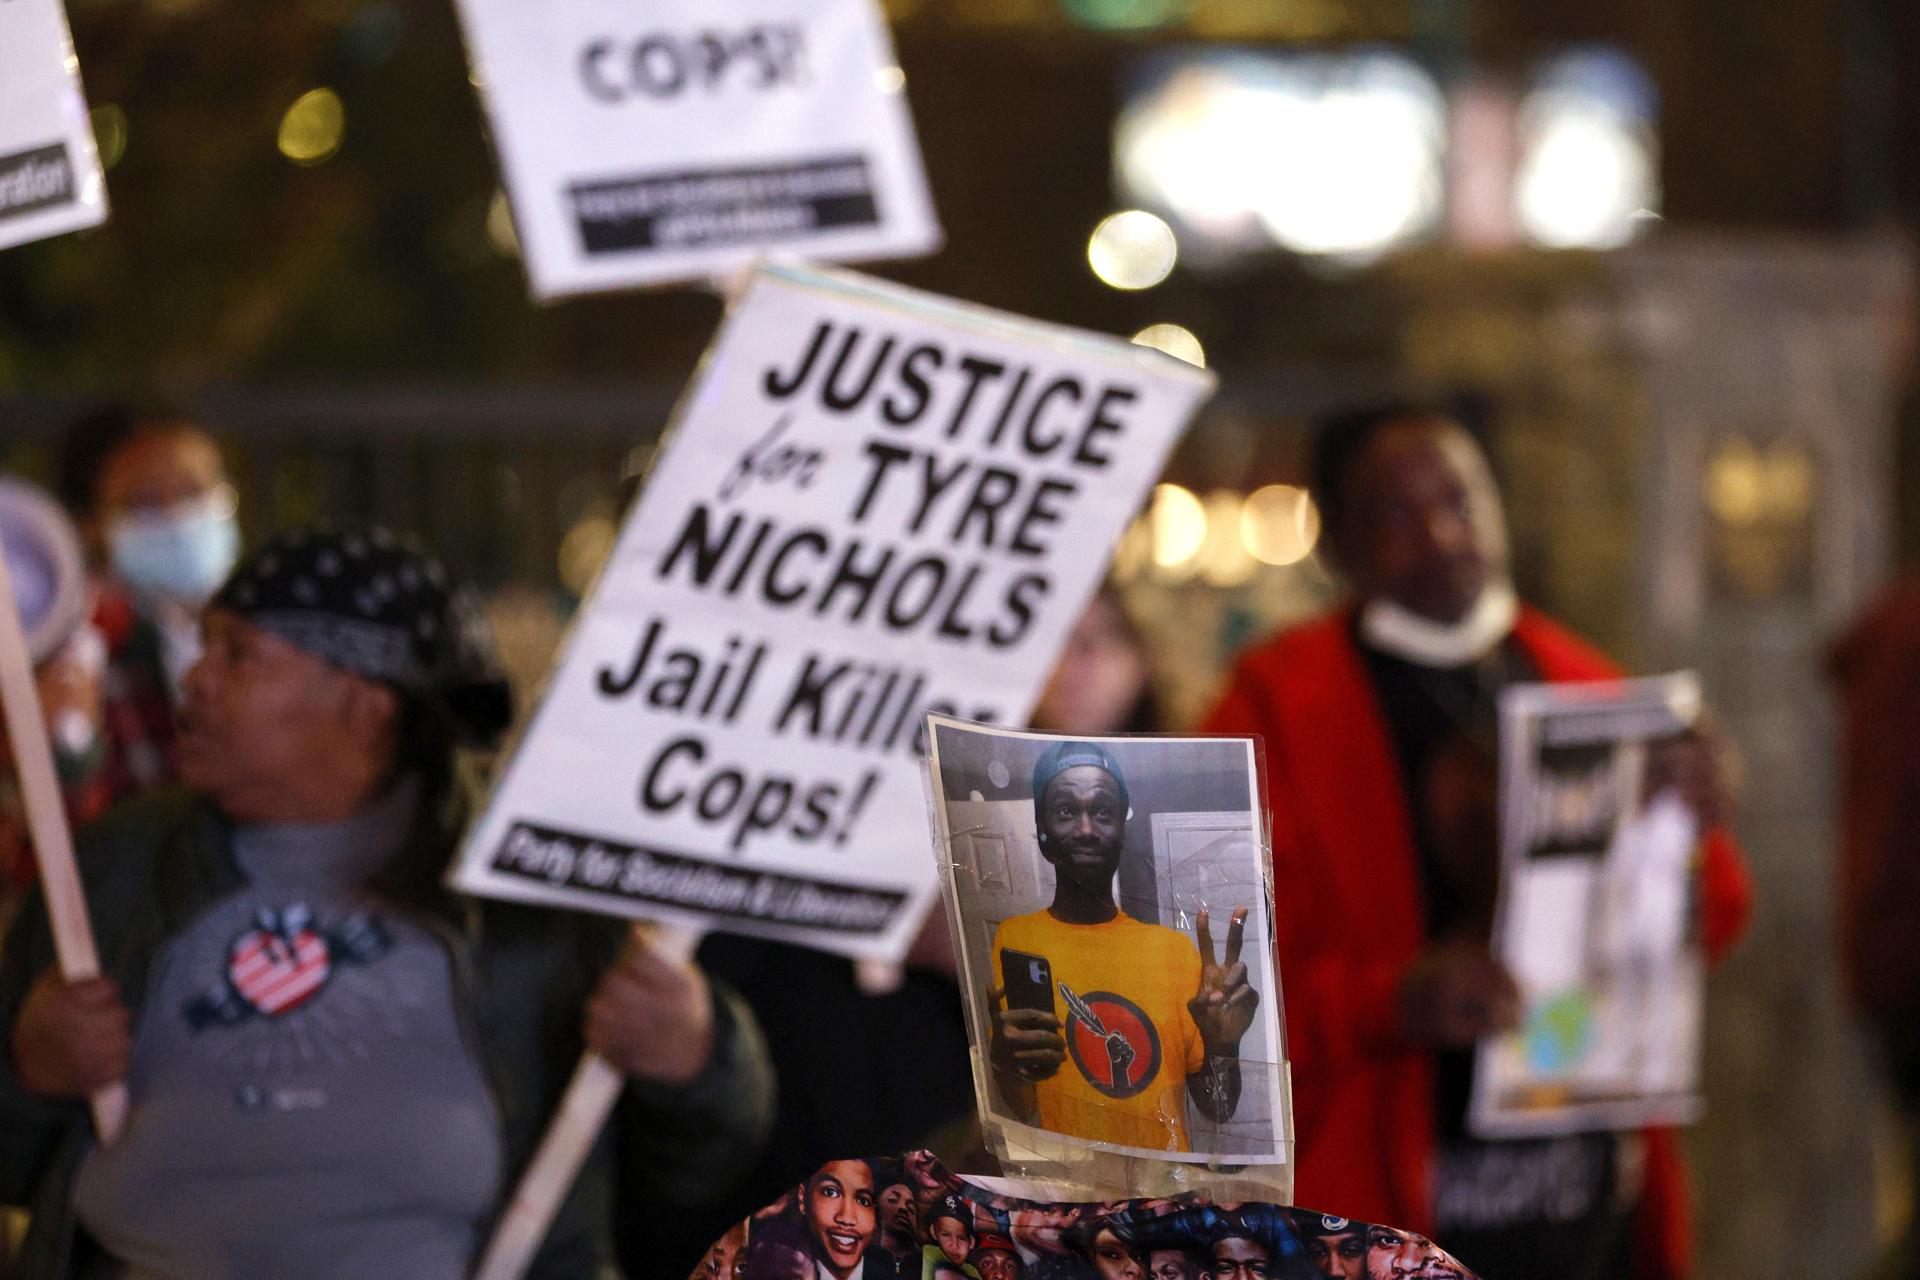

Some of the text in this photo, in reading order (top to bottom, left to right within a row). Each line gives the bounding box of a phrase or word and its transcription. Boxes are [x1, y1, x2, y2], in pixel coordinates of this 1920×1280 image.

[764, 321, 1138, 468] JUSTICE
[717, 411, 1077, 558] for TYRE
[657, 503, 1048, 649] NICHOLS
[598, 619, 767, 722] Jail
[642, 737, 881, 850] Cops!
[506, 832, 578, 886] Party
